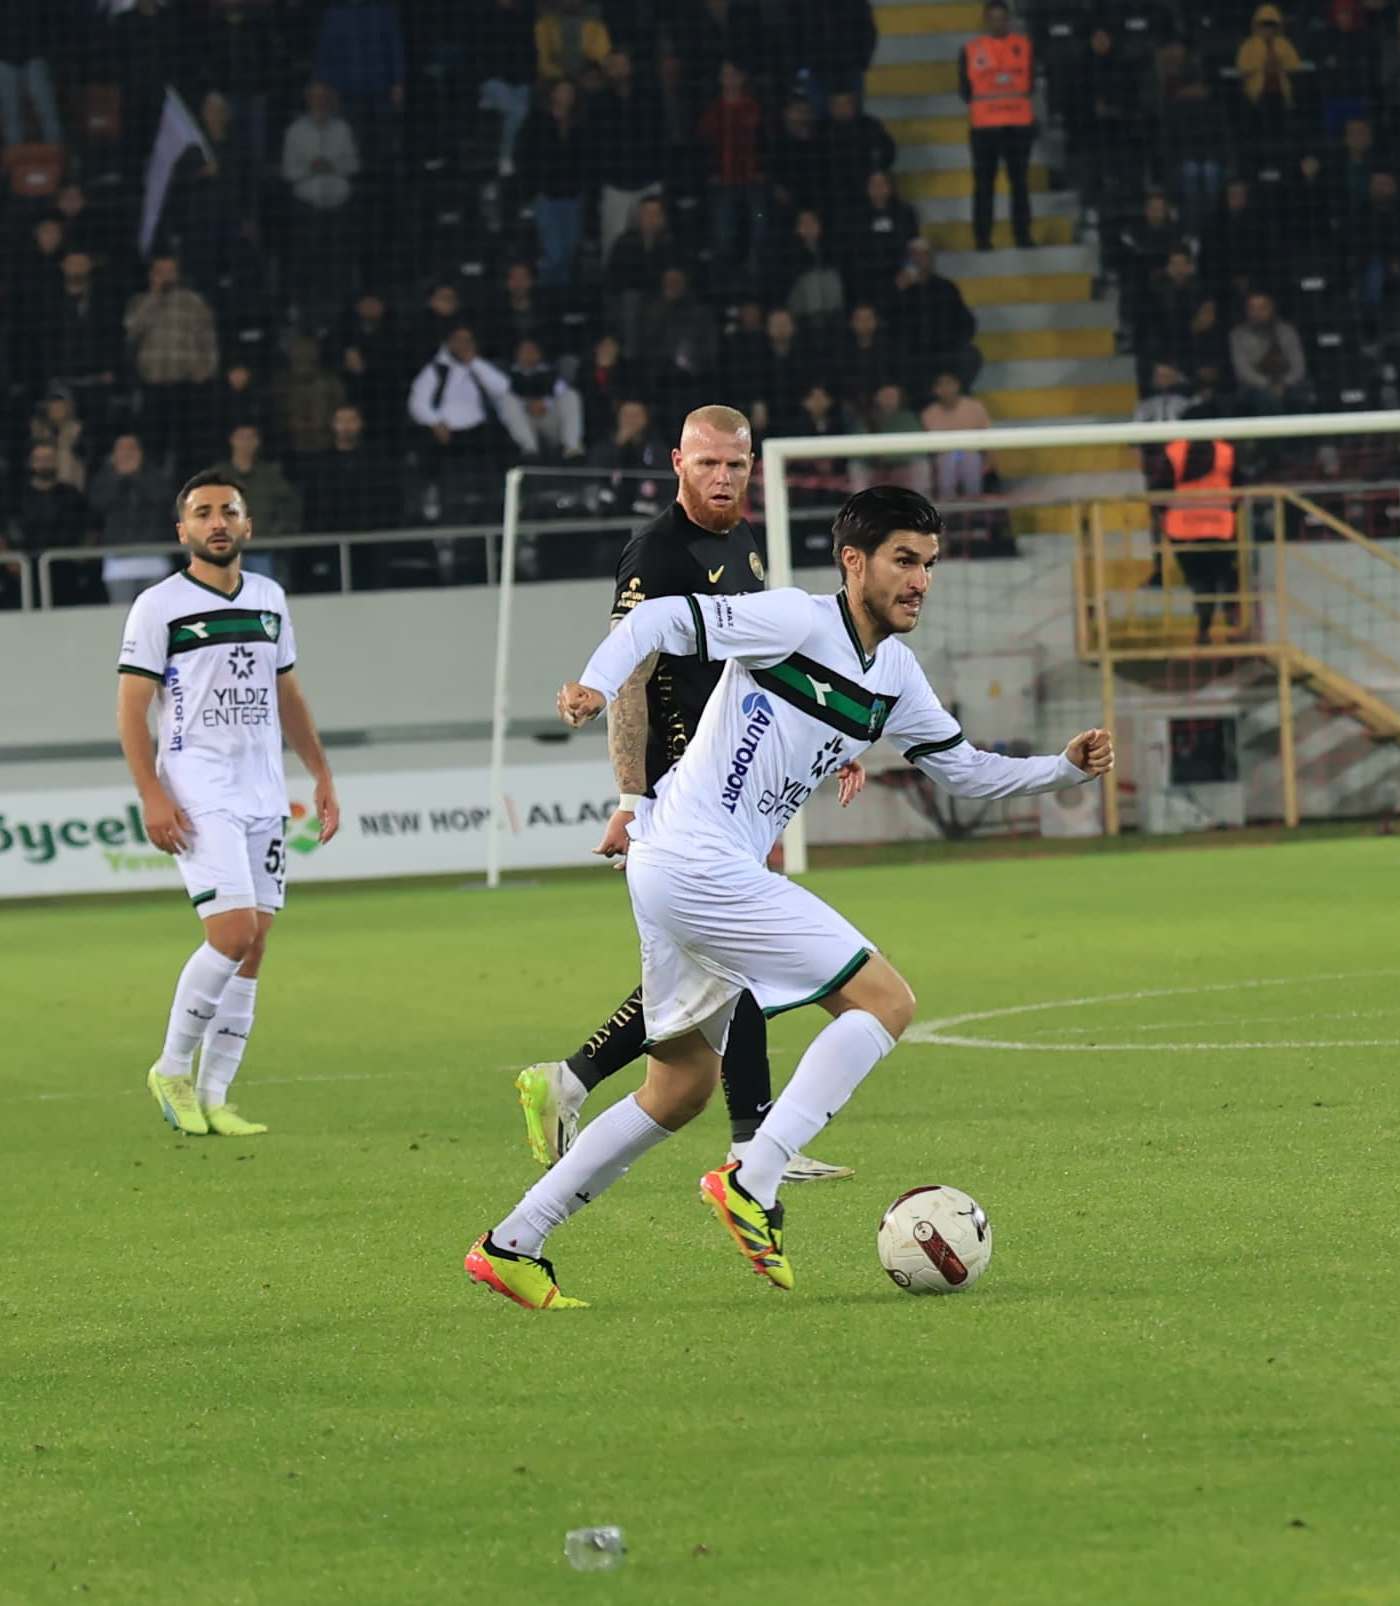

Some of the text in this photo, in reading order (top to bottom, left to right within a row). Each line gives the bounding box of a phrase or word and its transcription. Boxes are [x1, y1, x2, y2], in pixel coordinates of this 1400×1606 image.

[212, 687, 269, 706] YILDIZ
[721, 710, 771, 815] AUTOPORT
[359, 811, 421, 835] NEW
[428, 806, 499, 832] HOP
